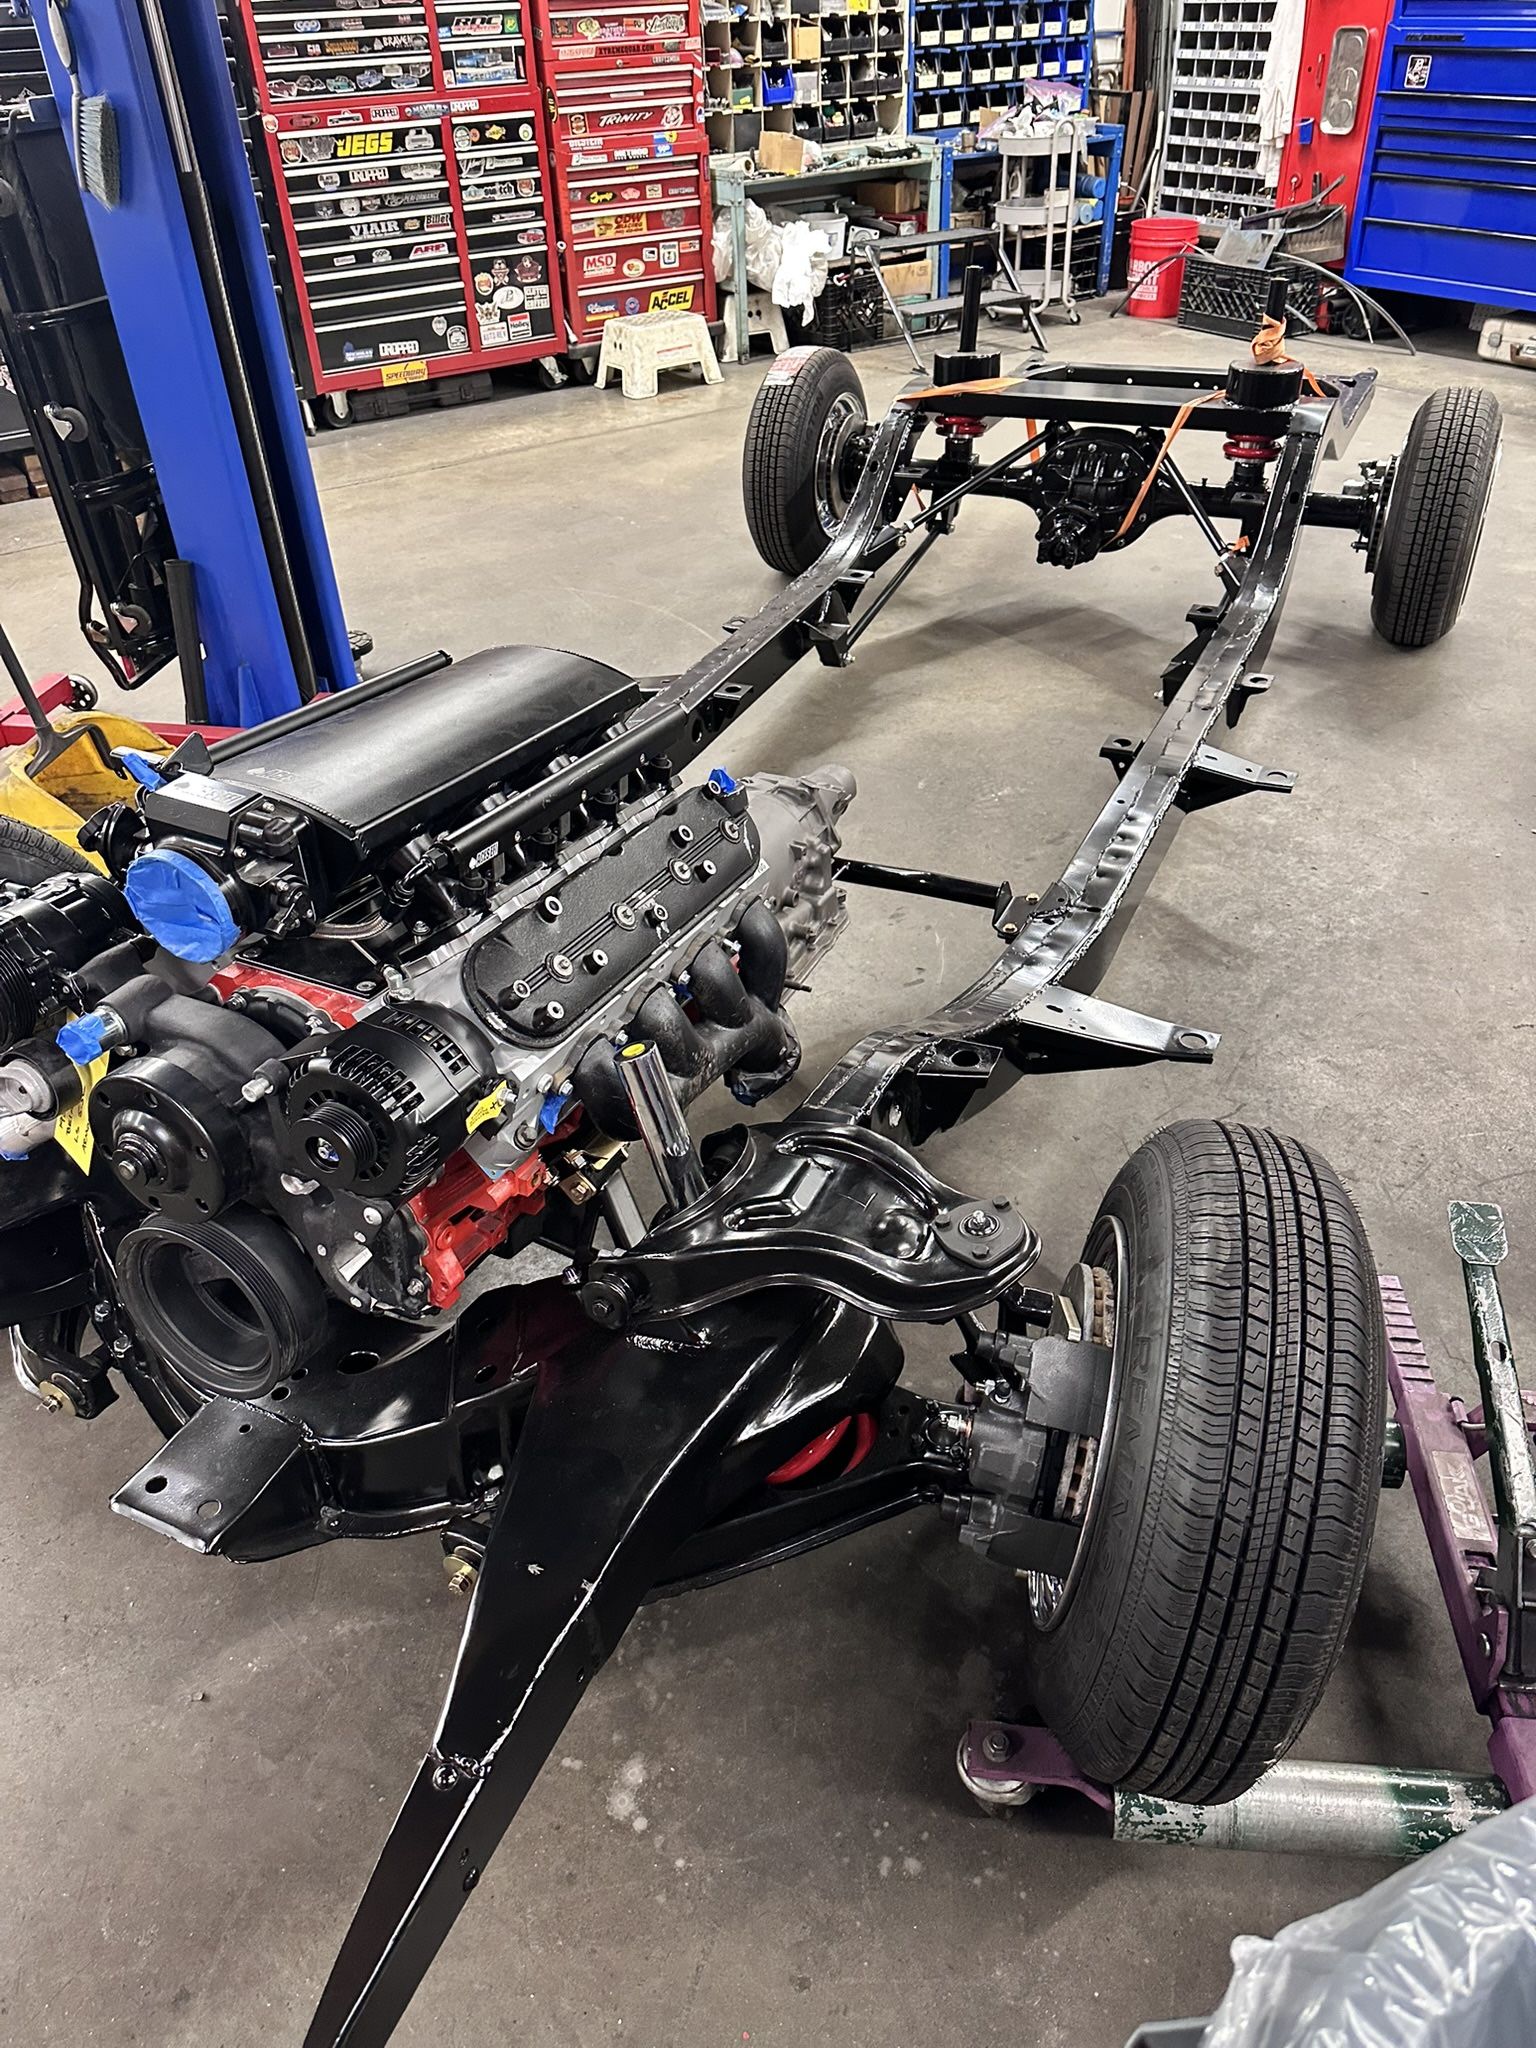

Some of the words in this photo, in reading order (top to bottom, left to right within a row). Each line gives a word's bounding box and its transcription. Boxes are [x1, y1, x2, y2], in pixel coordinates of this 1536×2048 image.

[599, 112, 653, 127] TRINITY
[337, 132, 393, 157] JEGS
[350, 220, 399, 236] VIAIR
[414, 244, 445, 254] ARP
[586, 256, 613, 268] MSD
[652, 291, 690, 310] ACCEL
